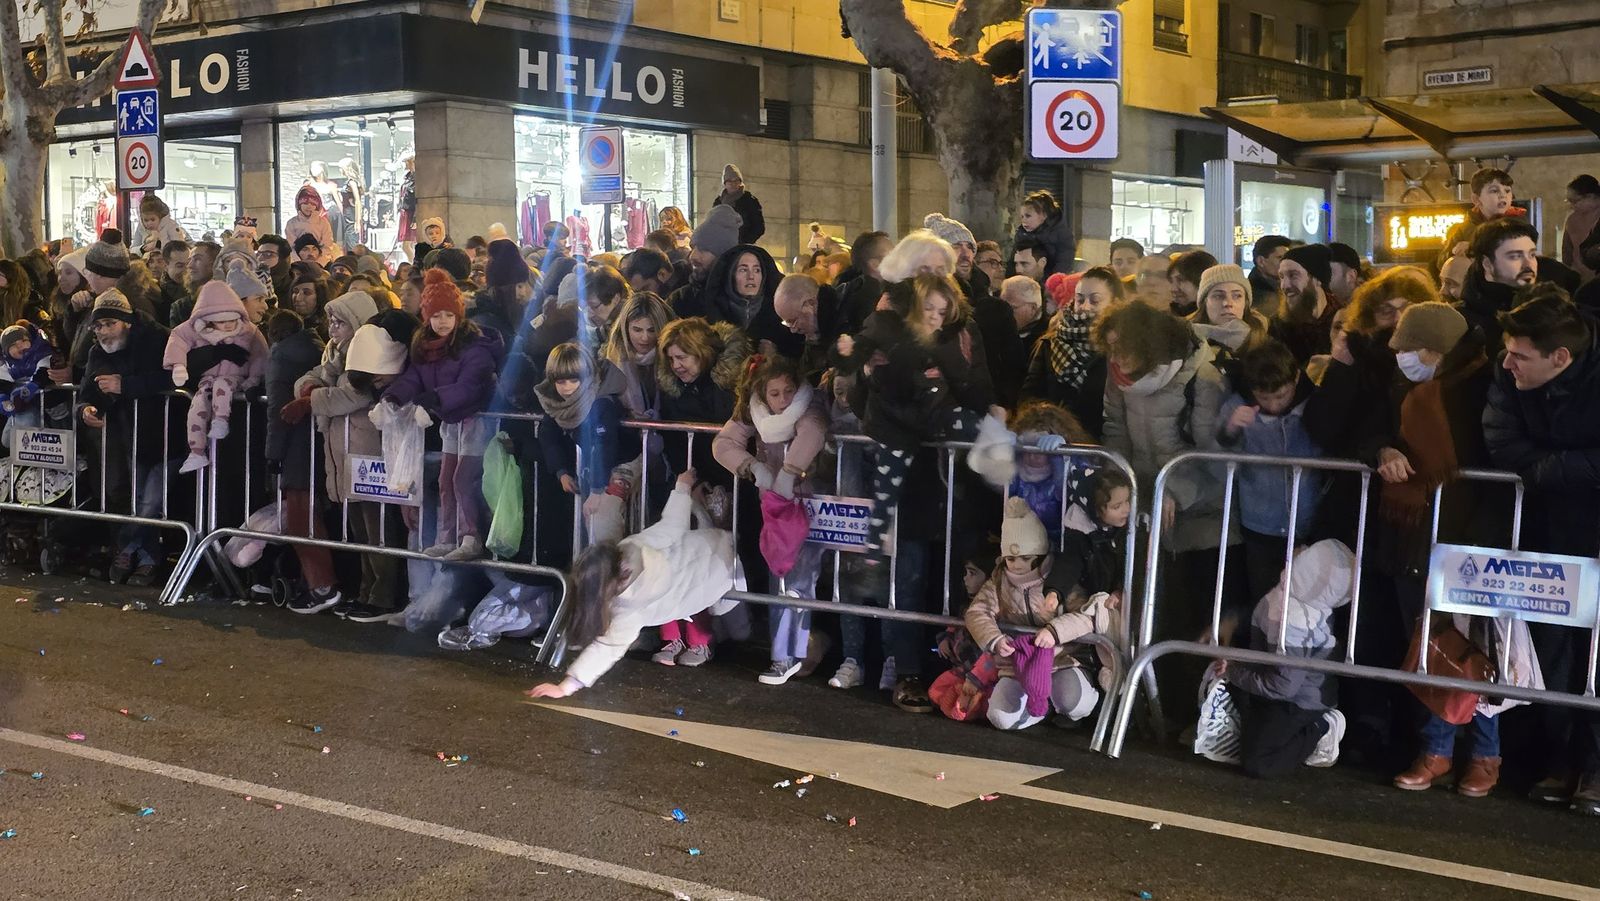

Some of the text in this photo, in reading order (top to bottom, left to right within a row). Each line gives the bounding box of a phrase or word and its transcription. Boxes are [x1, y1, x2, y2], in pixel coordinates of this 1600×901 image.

[237, 49, 250, 91] FASHION
[518, 48, 666, 104] HELLO
[672, 68, 685, 108] FASHION
[1060, 111, 1092, 131] 20
[131, 156, 146, 169] 20
[31, 432, 62, 444] METSA
[817, 519, 833, 527] 923
[849, 522, 859, 530] 45
[833, 534, 865, 543] ALQUIL
[1483, 557, 1566, 581] METSA
[1482, 577, 1565, 596] 923 22 45 24
[1452, 592, 1567, 613] VENTA Y ALQUILER
